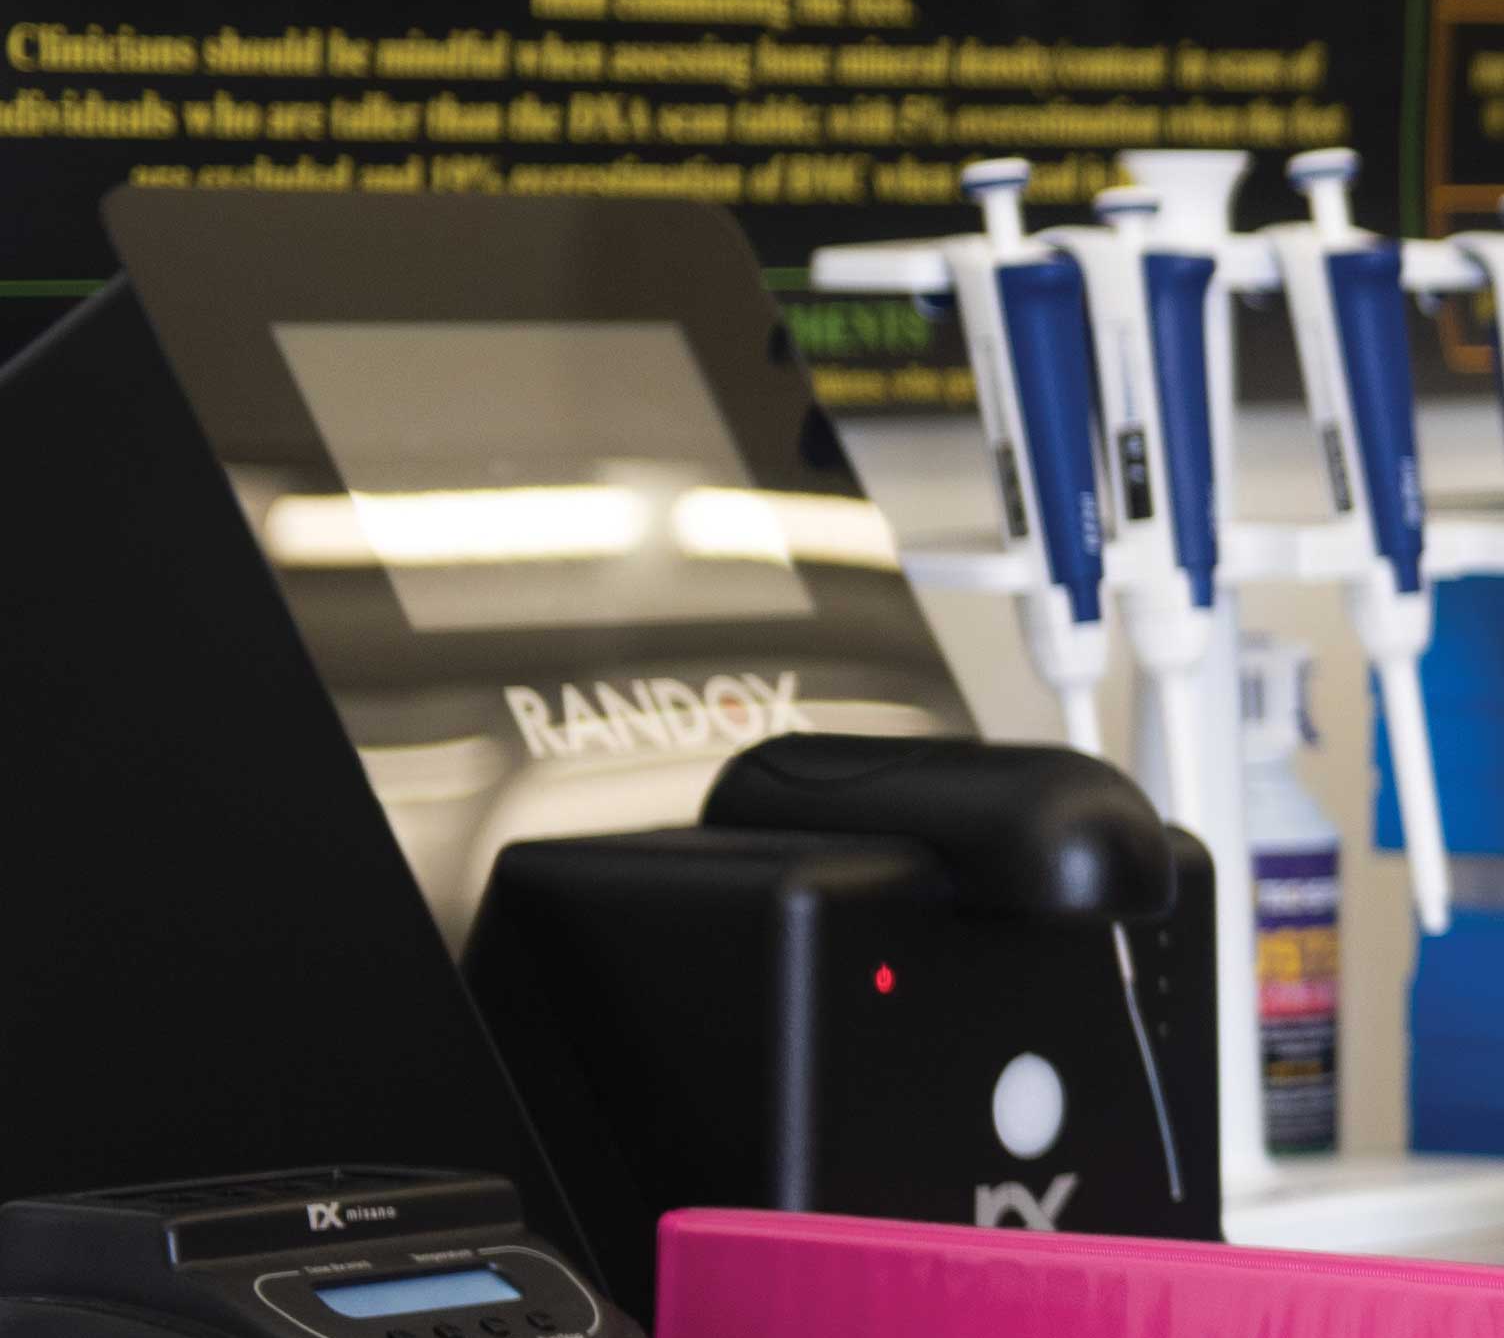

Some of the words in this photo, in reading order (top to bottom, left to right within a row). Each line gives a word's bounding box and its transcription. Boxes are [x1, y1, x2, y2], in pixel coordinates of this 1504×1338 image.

[7, 24, 198, 72] Clinicians
[0, 90, 177, 137] ndividuals
[503, 671, 815, 759] RANDOX
